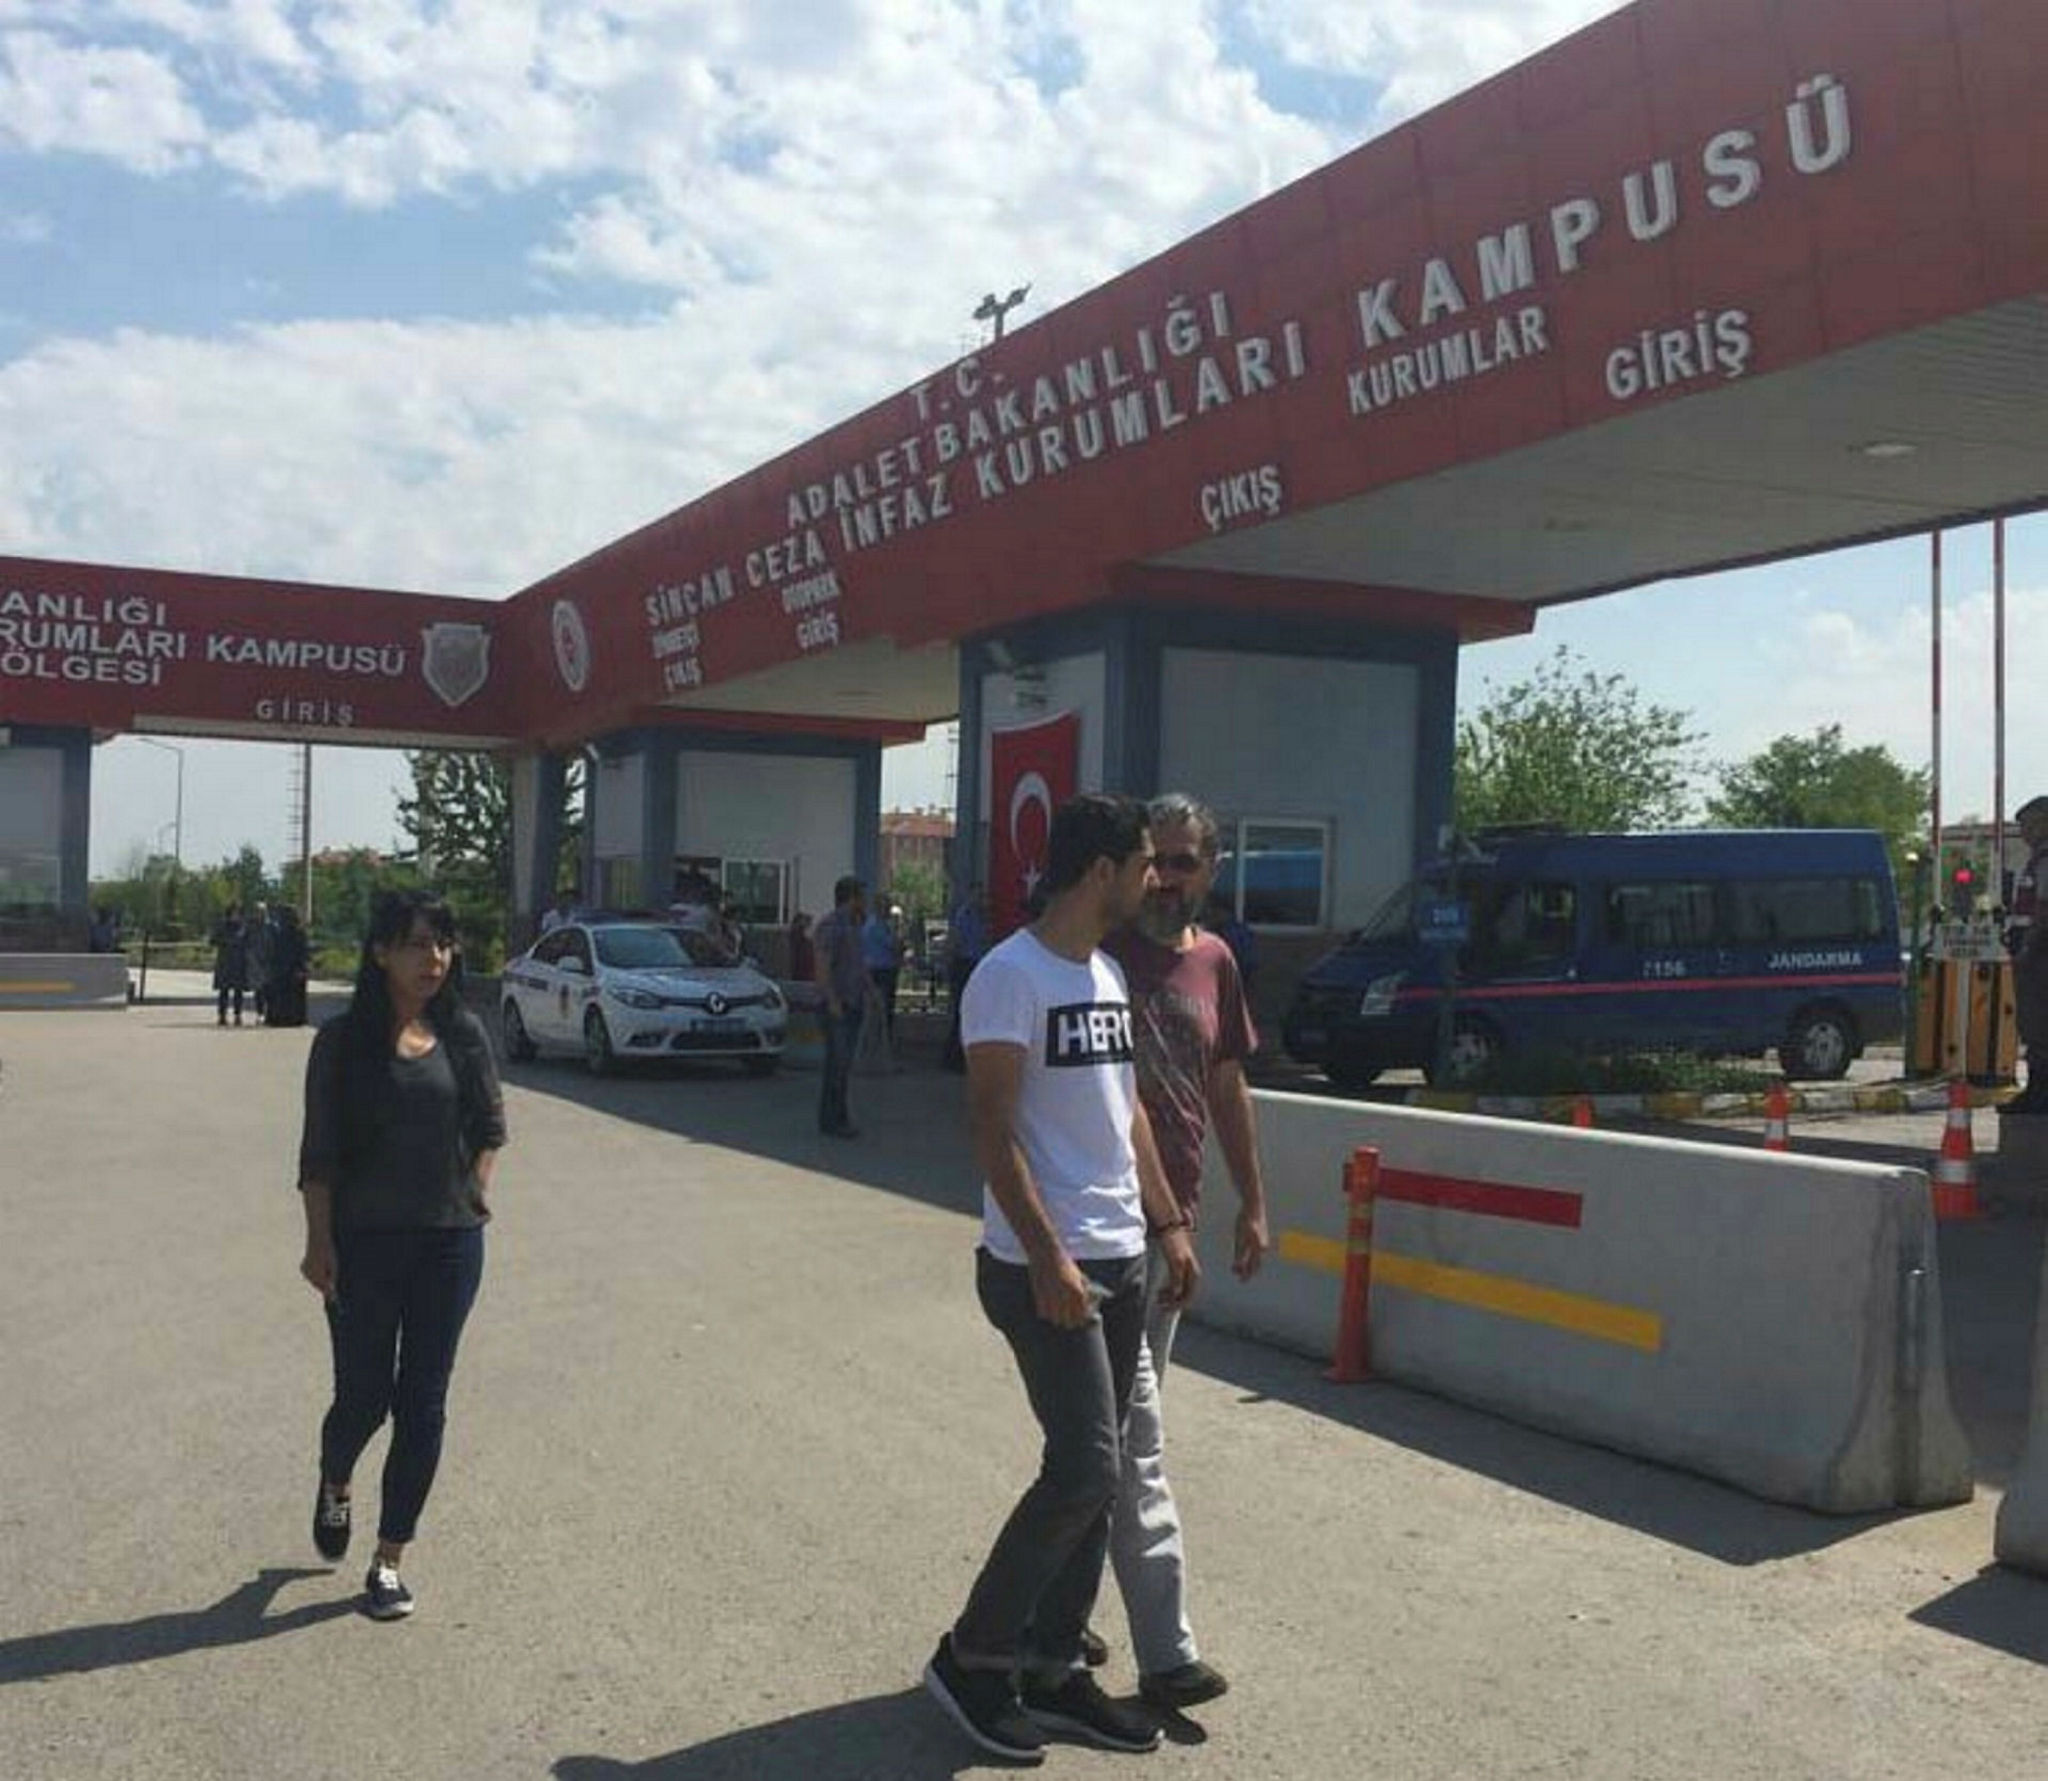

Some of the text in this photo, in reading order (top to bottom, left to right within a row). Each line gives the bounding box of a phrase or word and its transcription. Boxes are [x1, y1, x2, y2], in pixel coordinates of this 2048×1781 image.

[646, 564, 734, 627] SİNCAN
[746, 532, 826, 588] CEZA
[840, 474, 952, 552] İNFAZ
[975, 320, 1308, 500] KURUMLARI
[1358, 74, 1852, 348] KAMPUSÜ
[1347, 306, 1549, 415] KURUMLAR
[1605, 309, 1752, 400] GİRİŞ
[787, 290, 1234, 528] ADALET BAKANLIĞI
[908, 355, 1004, 421] T.C.
[1200, 463, 1283, 532] ÇIKIŞ
[206, 635, 406, 677] KAMPUSÜ
[255, 698, 355, 726] GİRİŞ
[1767, 950, 1863, 970] JANDARMA
